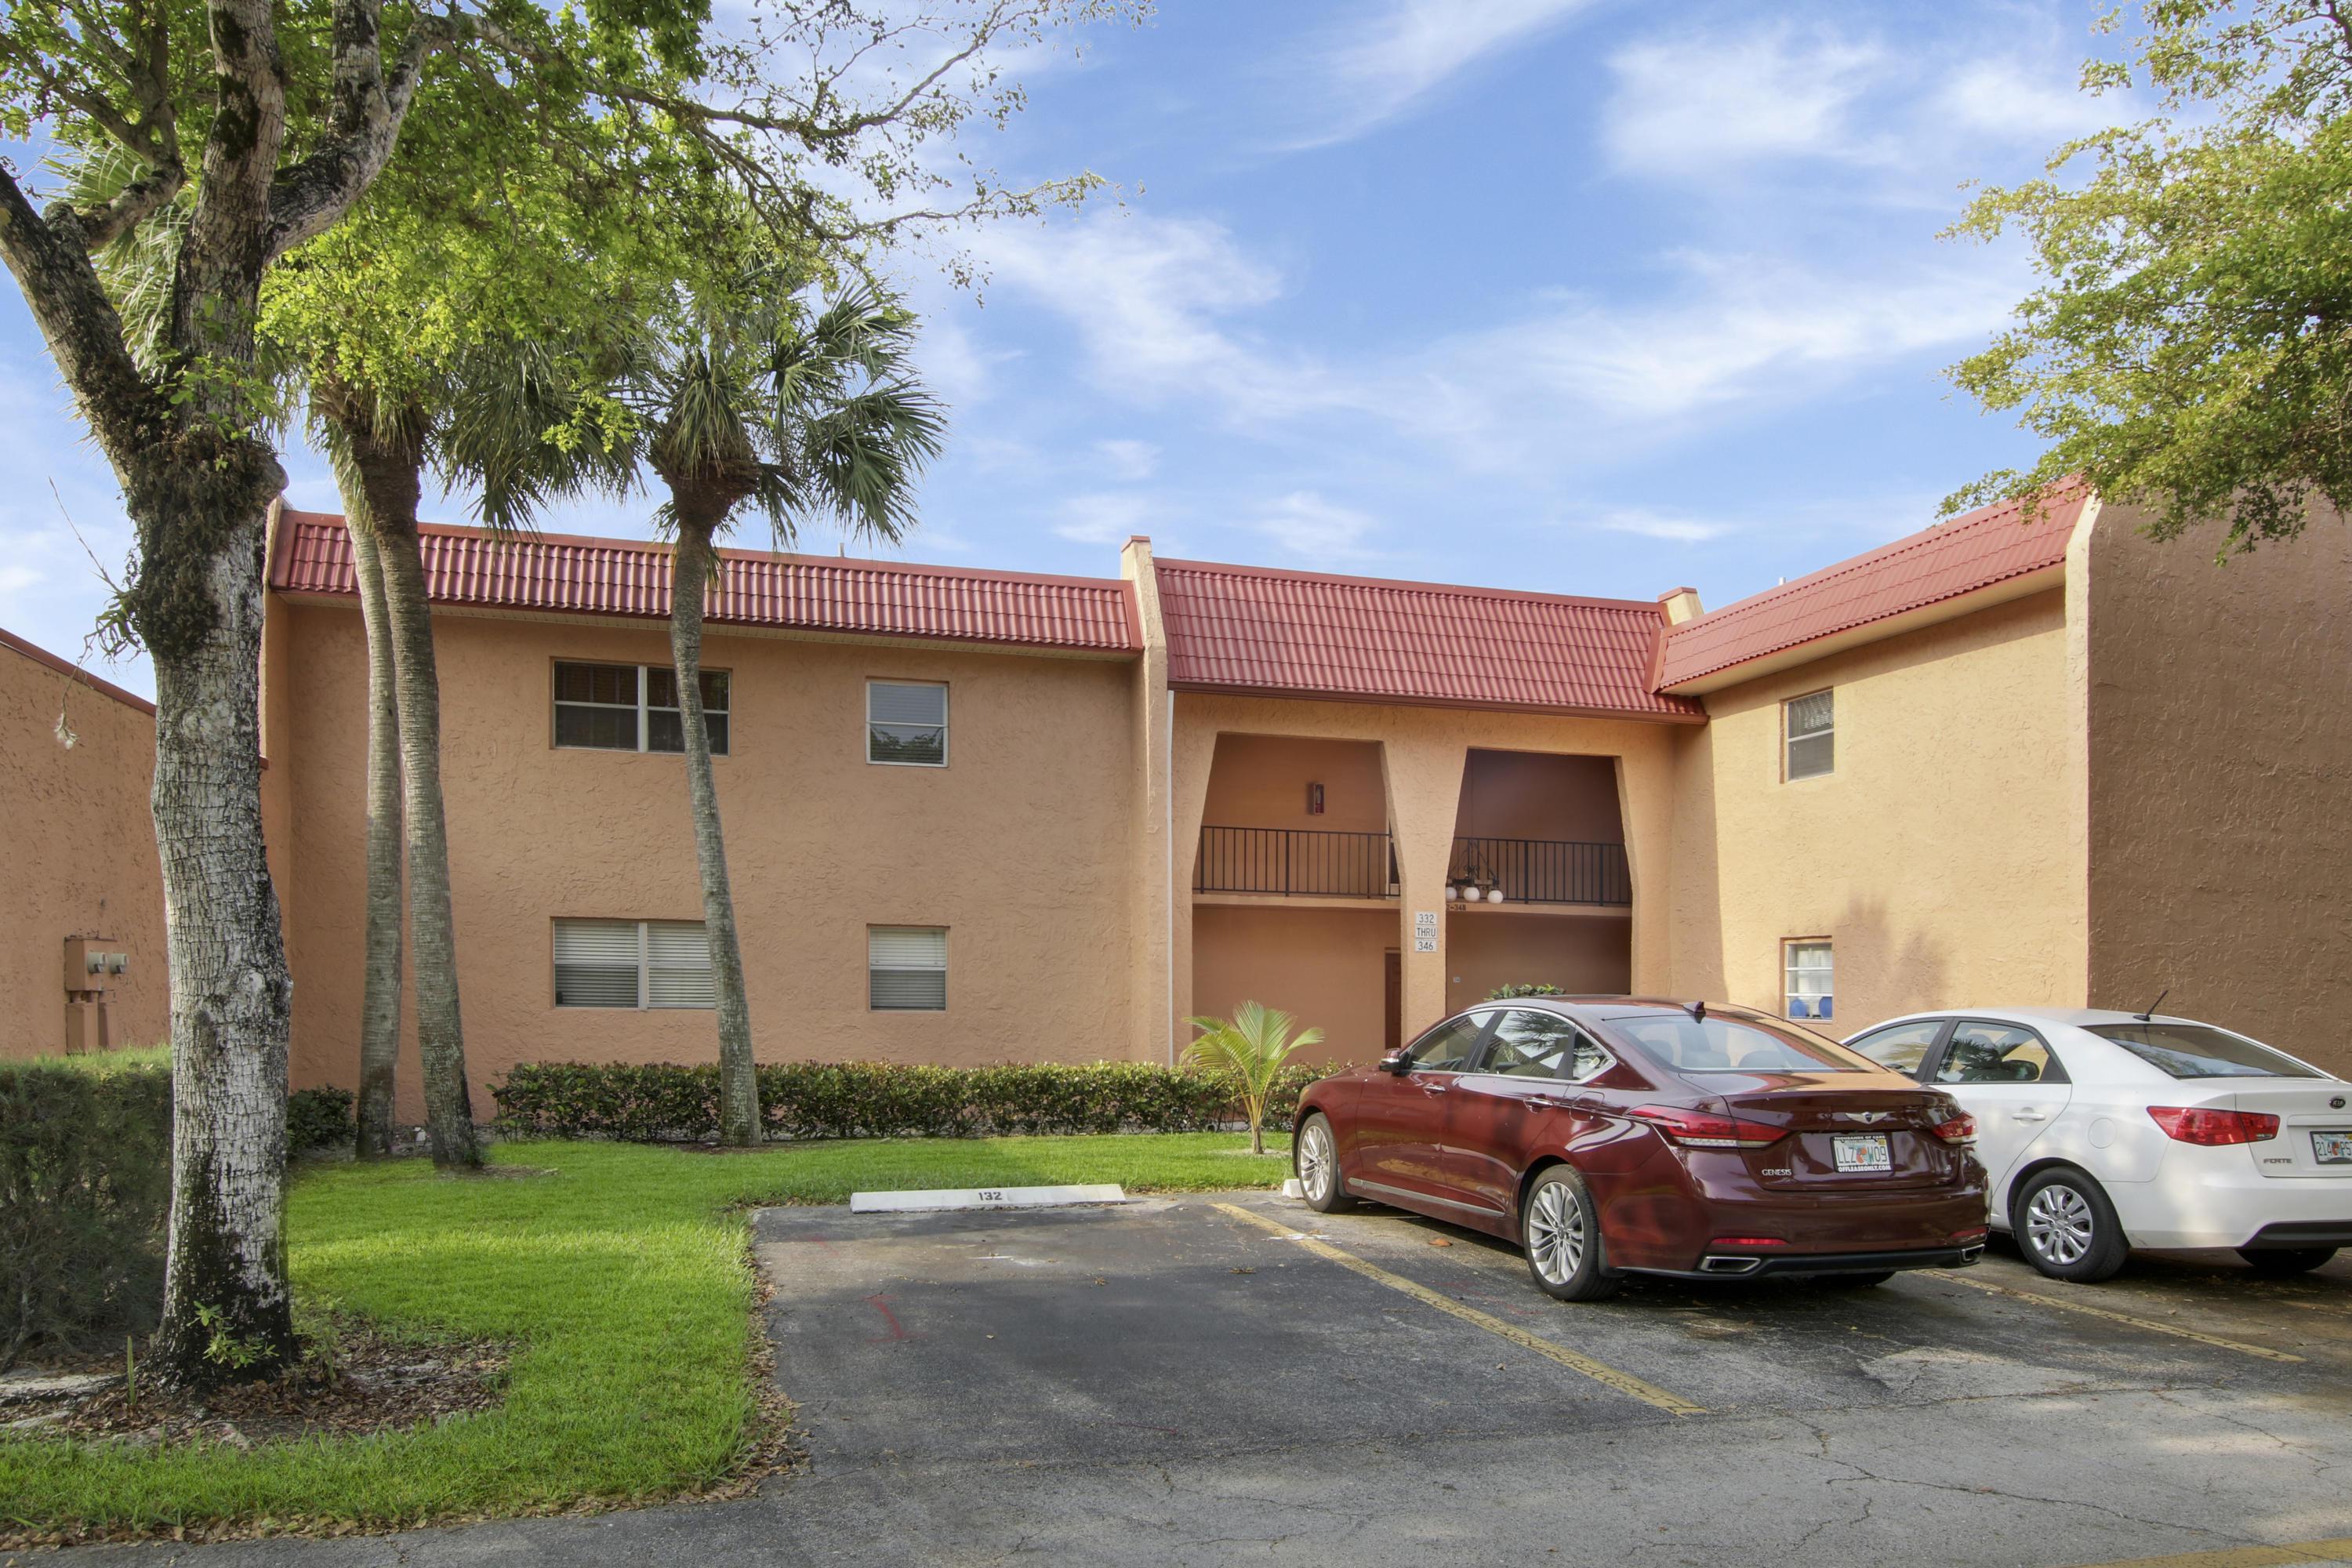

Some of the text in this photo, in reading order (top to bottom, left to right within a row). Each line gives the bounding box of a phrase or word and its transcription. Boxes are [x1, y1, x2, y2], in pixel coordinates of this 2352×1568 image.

[1418, 913, 1435, 924] 332
[1417, 927, 1436, 937] THRU
[1417, 941, 1434, 950] 346
[978, 1192, 1003, 1201] 132
